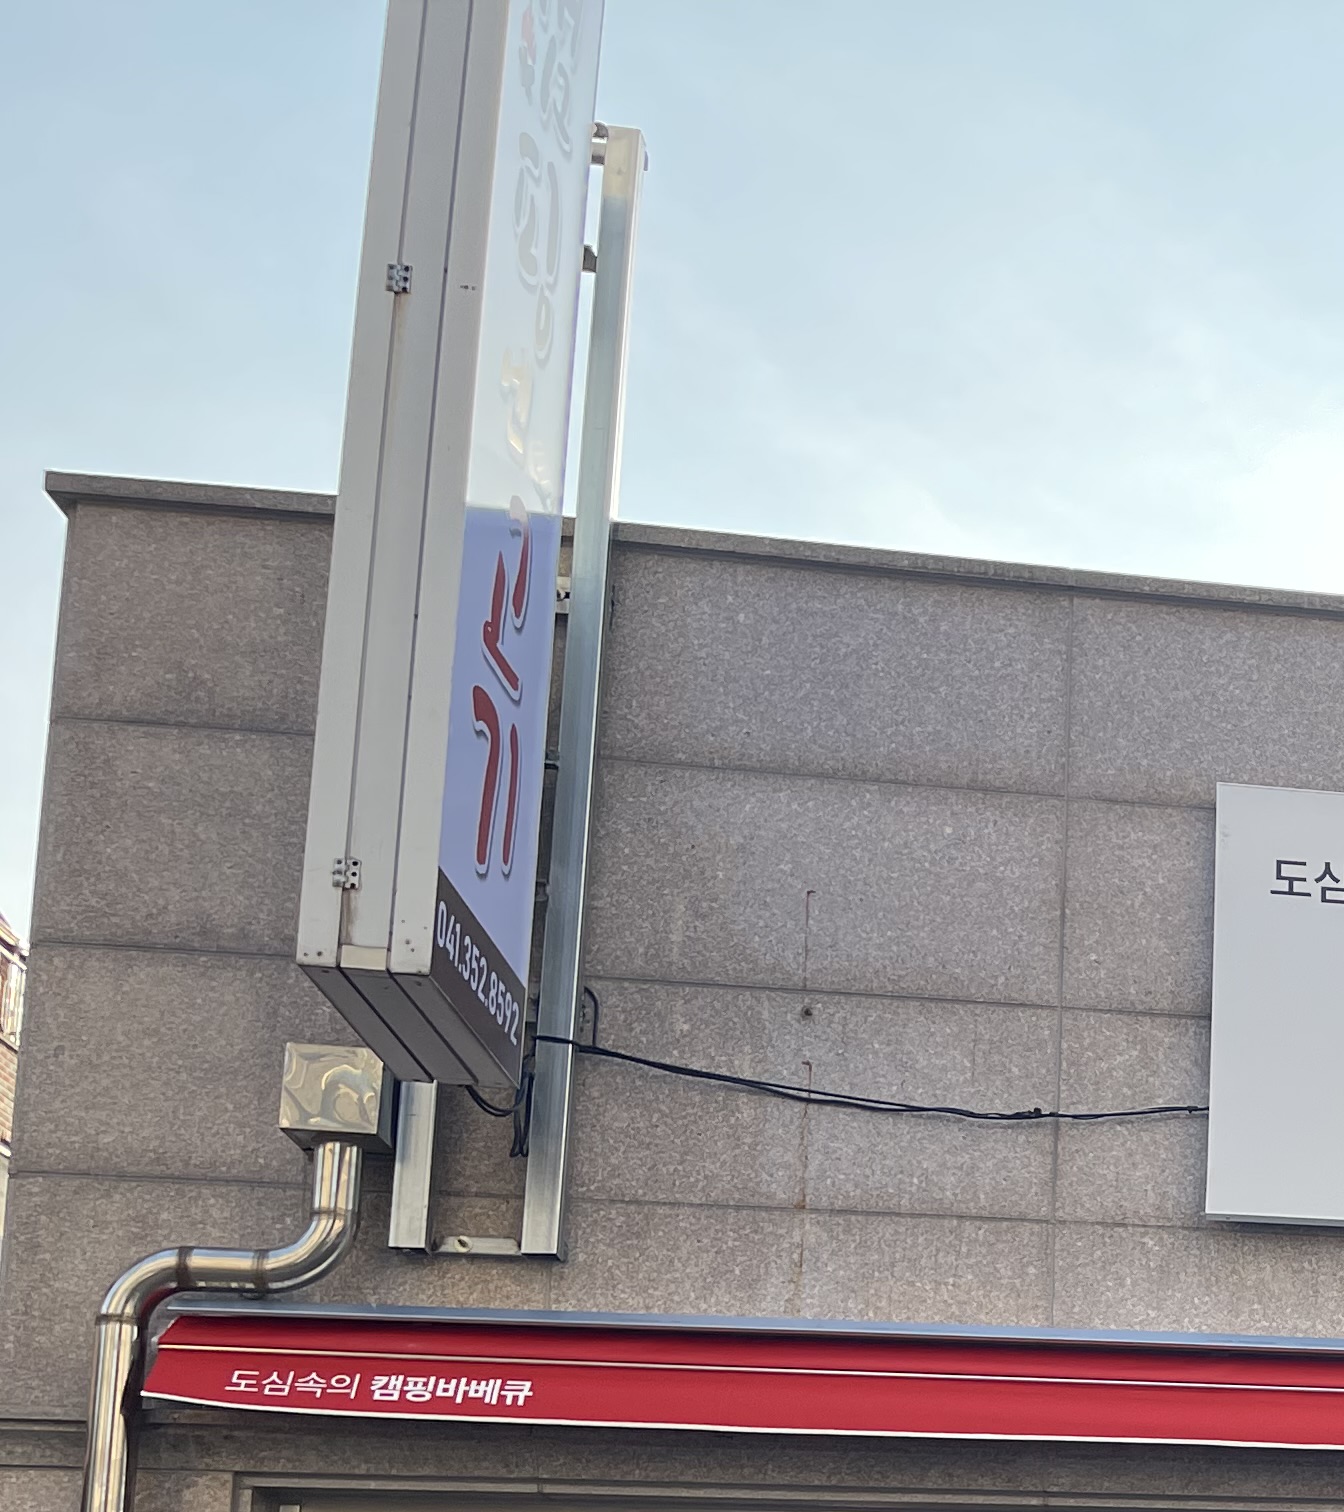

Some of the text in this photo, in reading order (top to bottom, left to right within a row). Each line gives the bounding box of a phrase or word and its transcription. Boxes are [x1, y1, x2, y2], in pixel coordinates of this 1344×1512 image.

[436, 900, 520, 1046] 041.352.8592
[224, 1368, 534, 1406] 도심속의 캠핑바베큐
